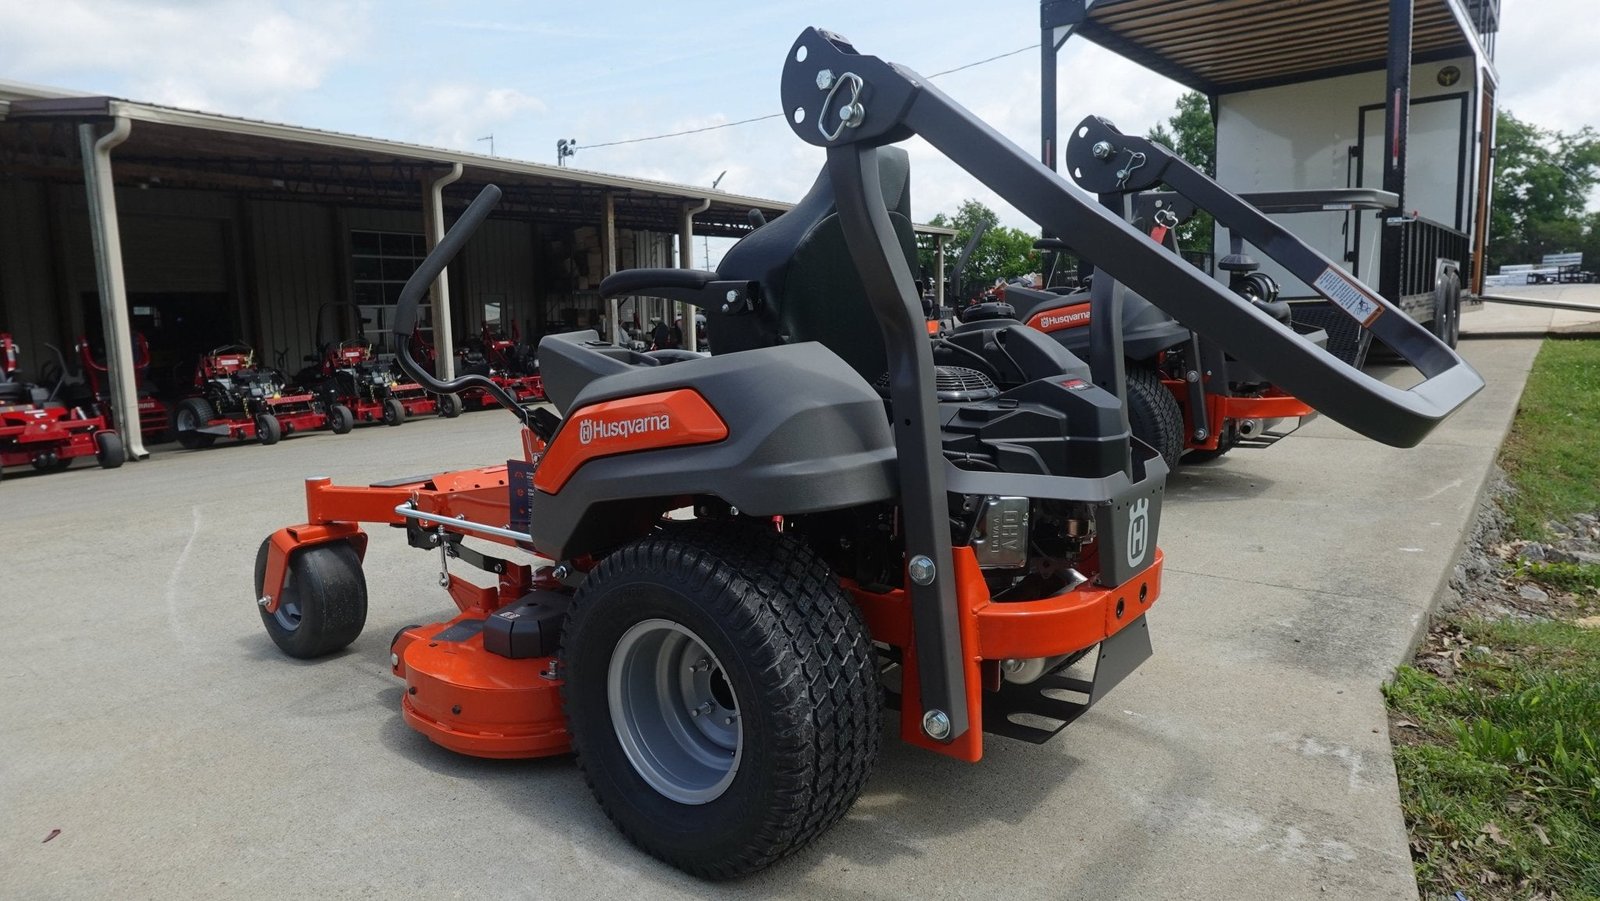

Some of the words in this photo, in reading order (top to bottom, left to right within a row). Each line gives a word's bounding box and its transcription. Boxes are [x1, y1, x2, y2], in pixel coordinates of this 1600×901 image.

[1050, 311, 1090, 325] Husqvarna
[594, 415, 670, 439] Husqvarna
[1002, 510, 1018, 550] OHV
